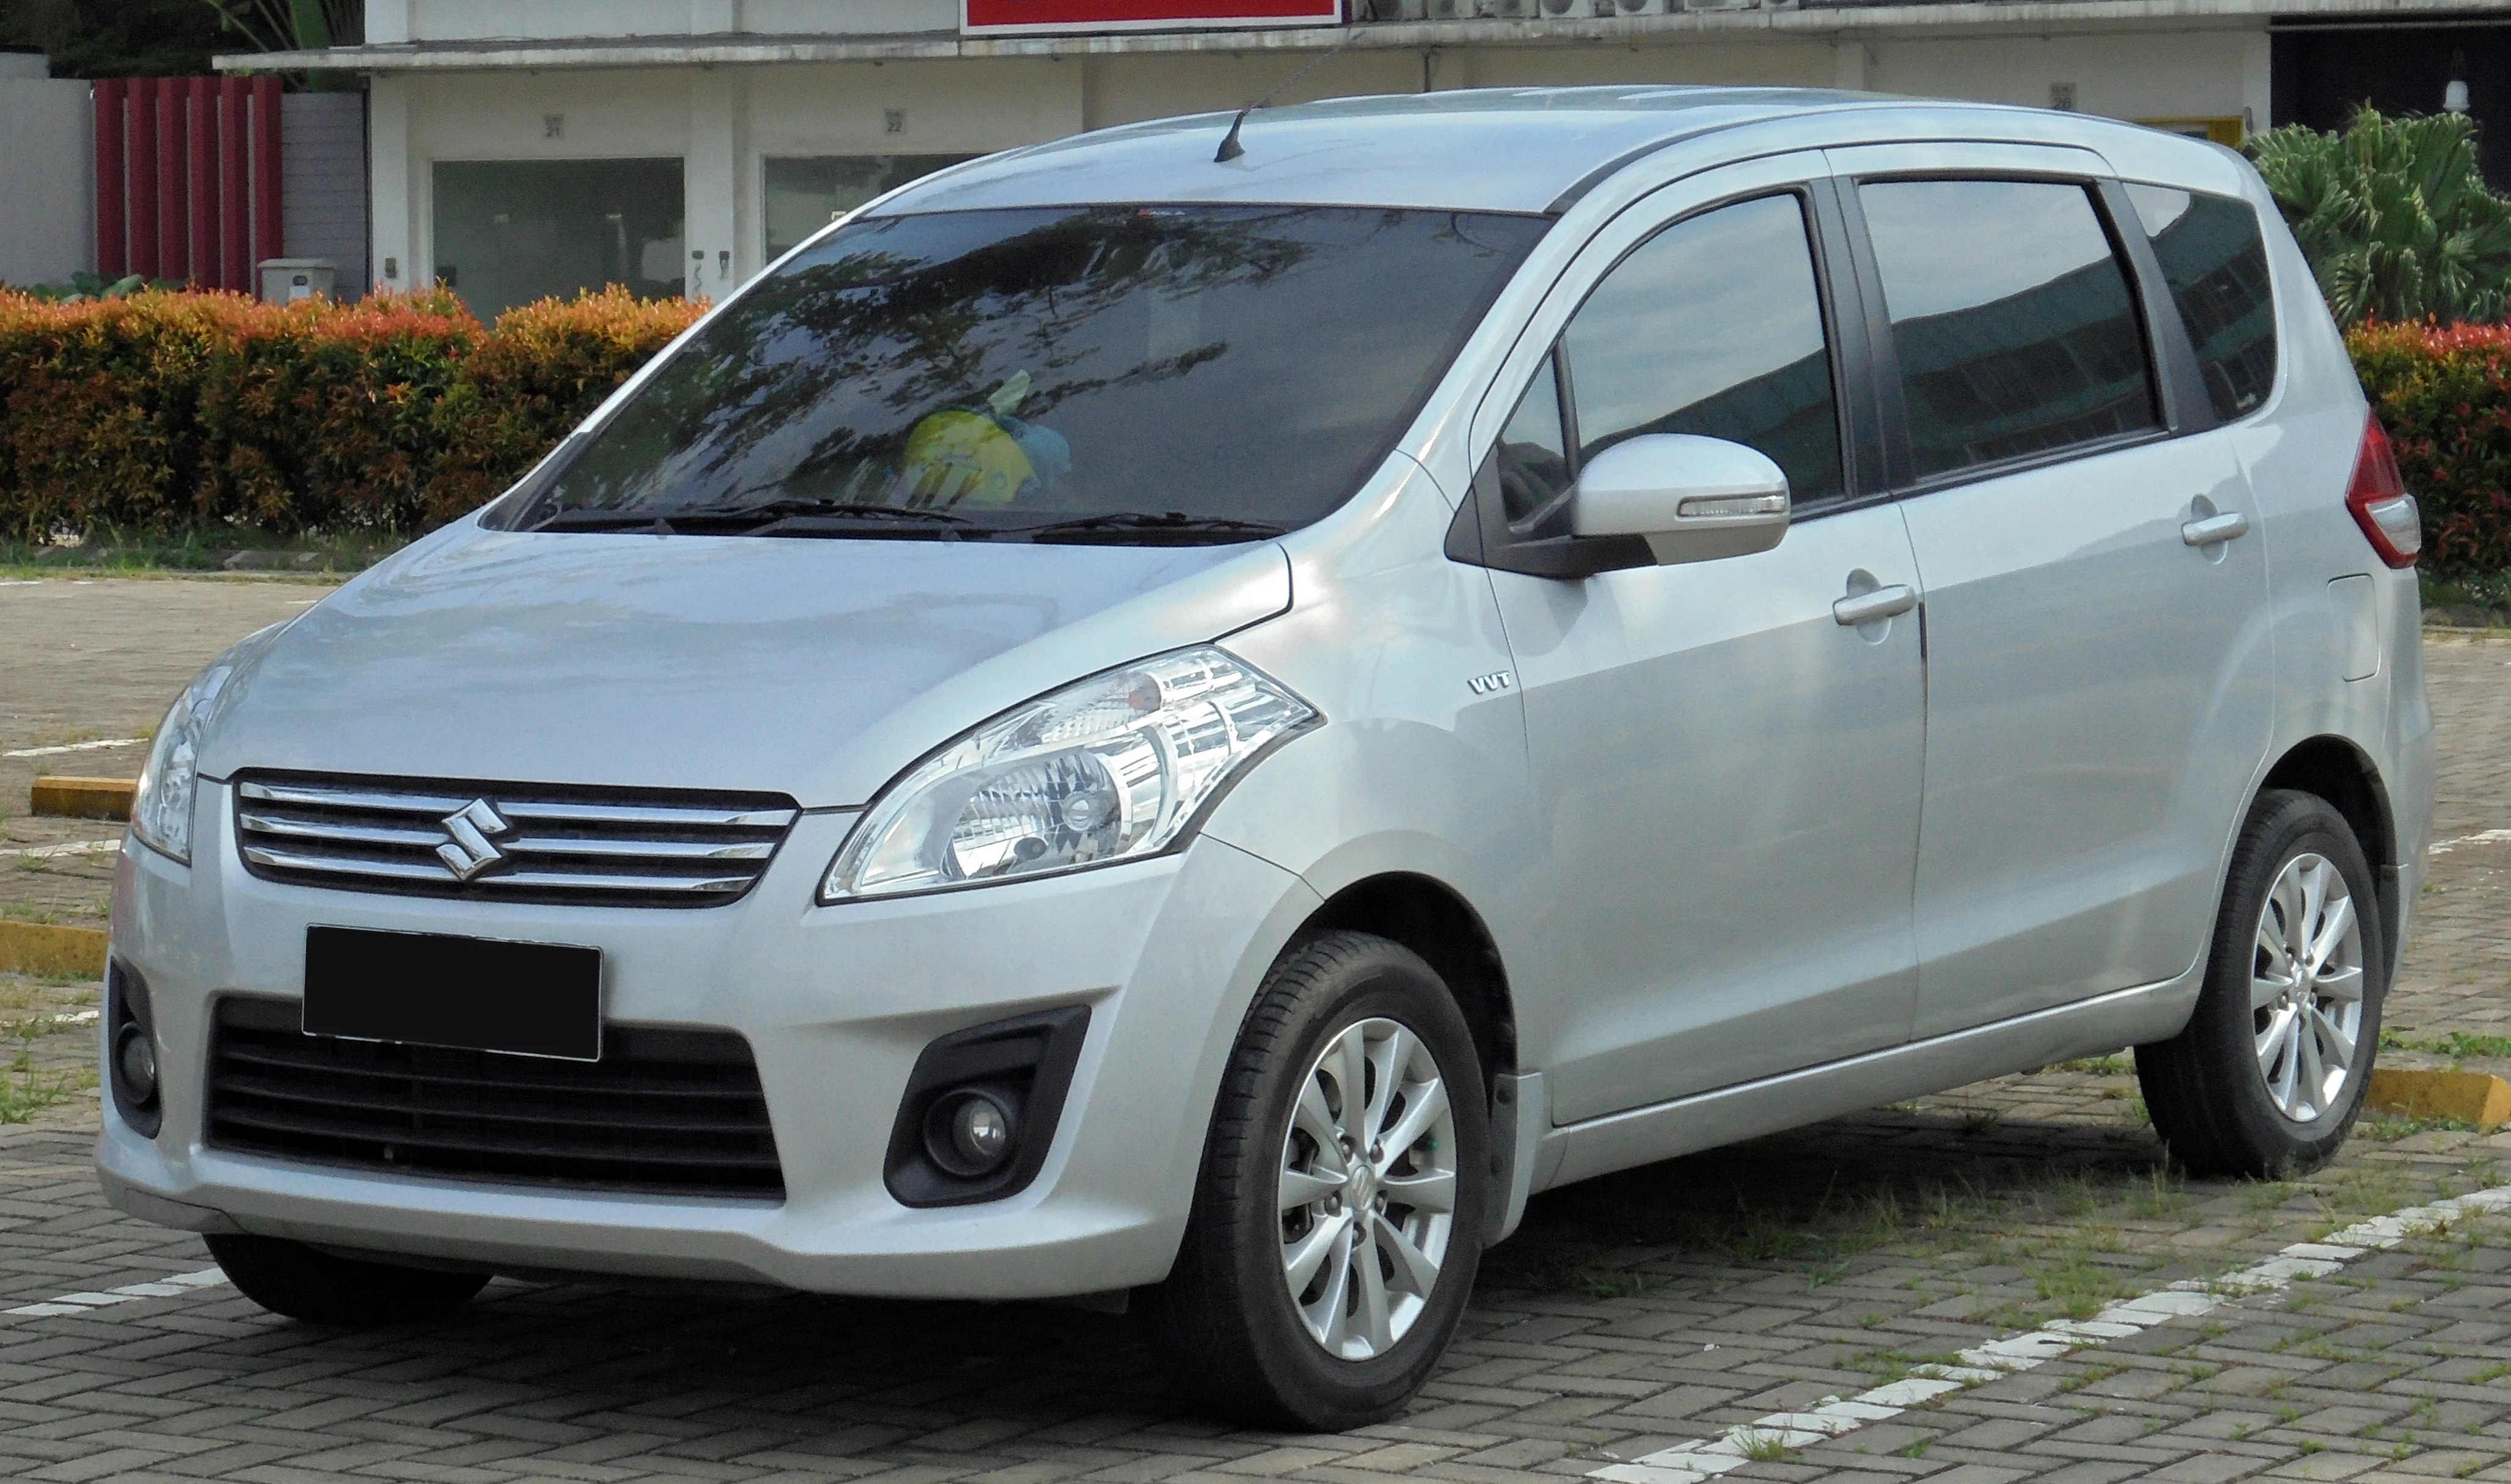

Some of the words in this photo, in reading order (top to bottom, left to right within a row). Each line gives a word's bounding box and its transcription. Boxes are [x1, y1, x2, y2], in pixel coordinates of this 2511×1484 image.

[546, 126, 560, 137] 21
[887, 122, 902, 132] 22
[1467, 670, 1509, 695] VVT
